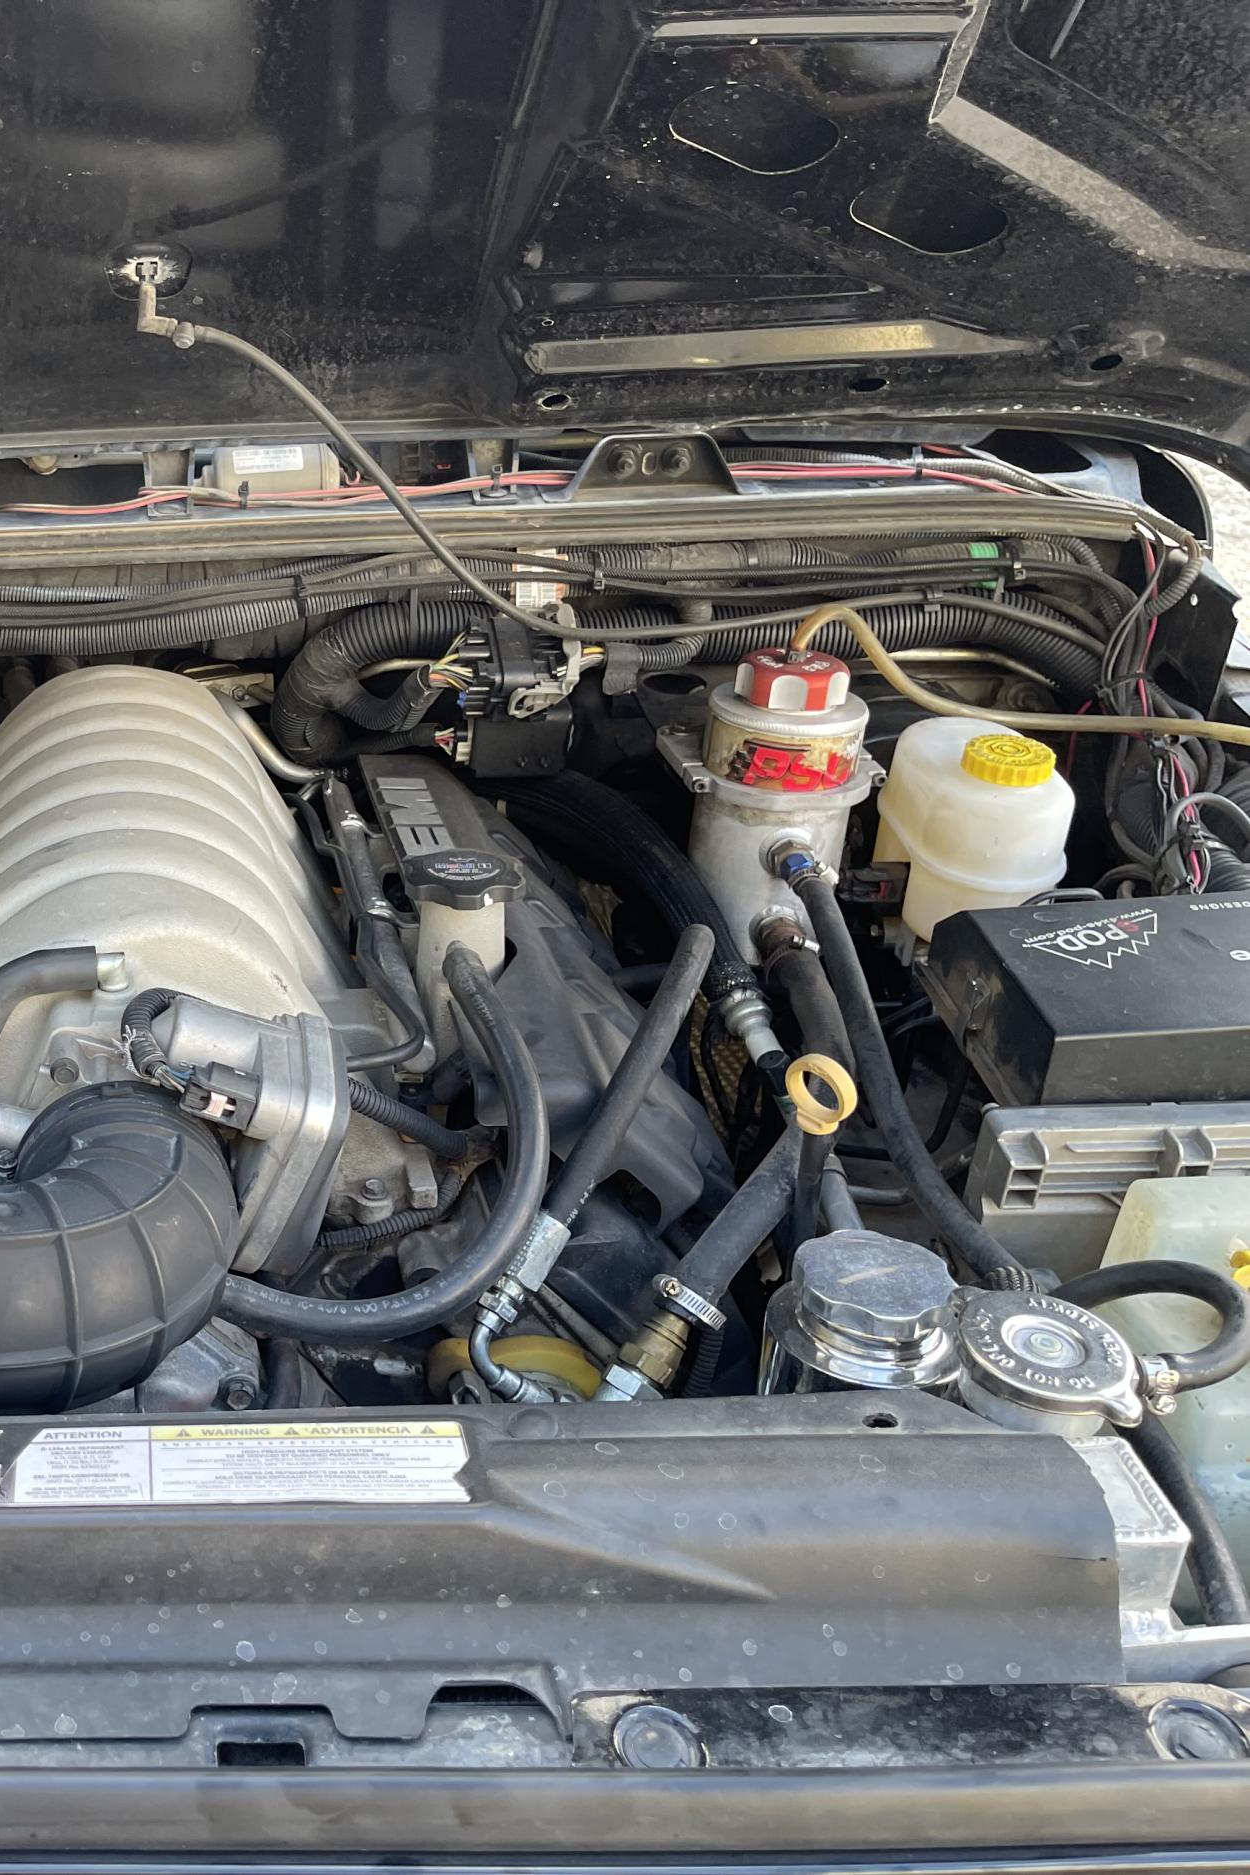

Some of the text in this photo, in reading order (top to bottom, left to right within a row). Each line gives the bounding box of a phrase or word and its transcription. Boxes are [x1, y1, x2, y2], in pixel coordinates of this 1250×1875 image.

[376, 777, 455, 857] EMI
[202, 1427, 270, 1436] WARNING
[310, 1425, 411, 1434] ADVERTENCIA
[44, 1431, 123, 1440] ATTENTION
